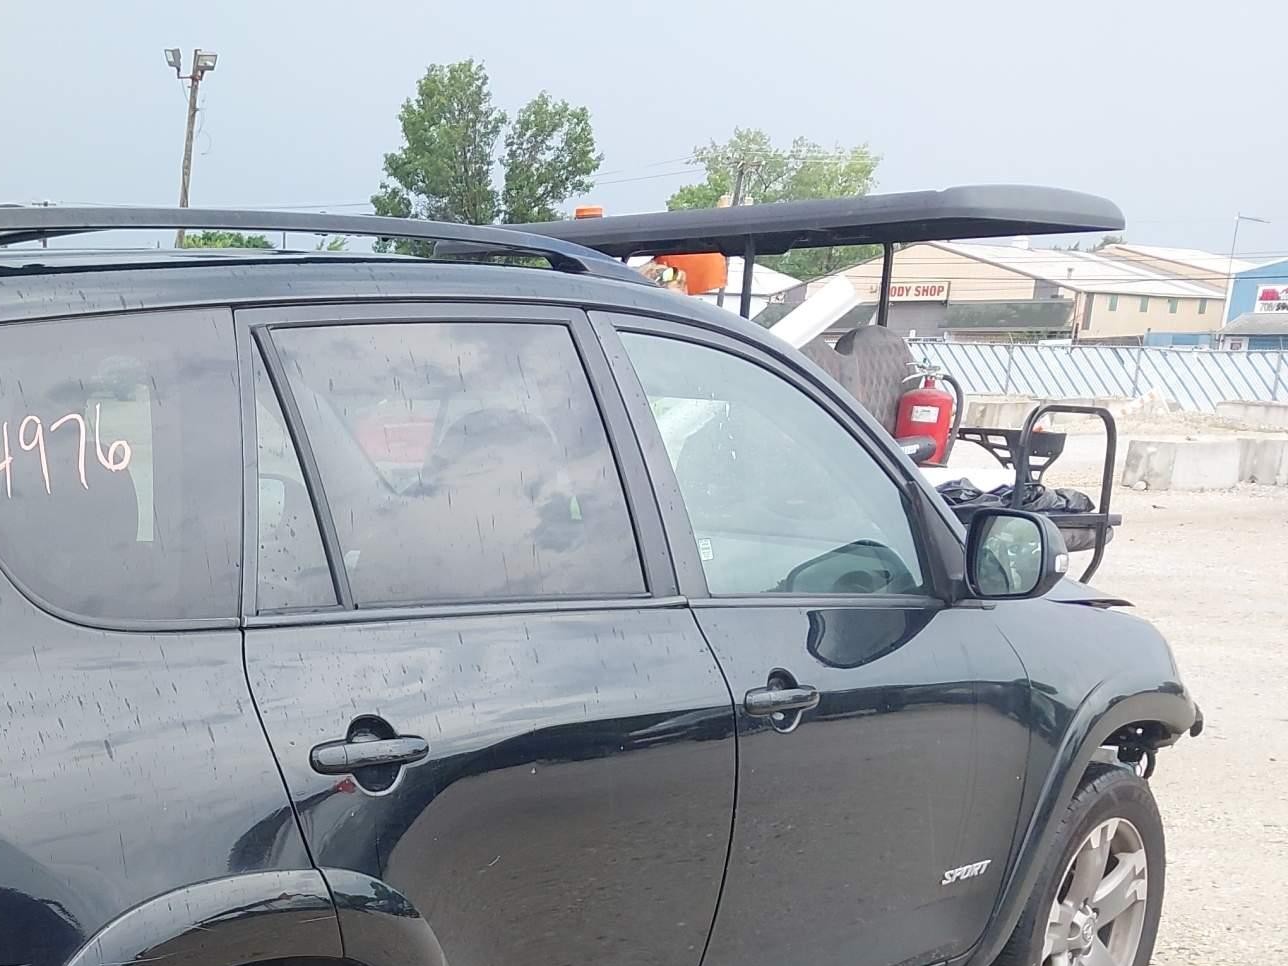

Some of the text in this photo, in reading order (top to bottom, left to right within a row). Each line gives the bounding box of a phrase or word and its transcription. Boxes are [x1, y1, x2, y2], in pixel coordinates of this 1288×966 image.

[888, 285, 945, 297] ODY SHOP
[941, 859, 992, 886] SPORT
